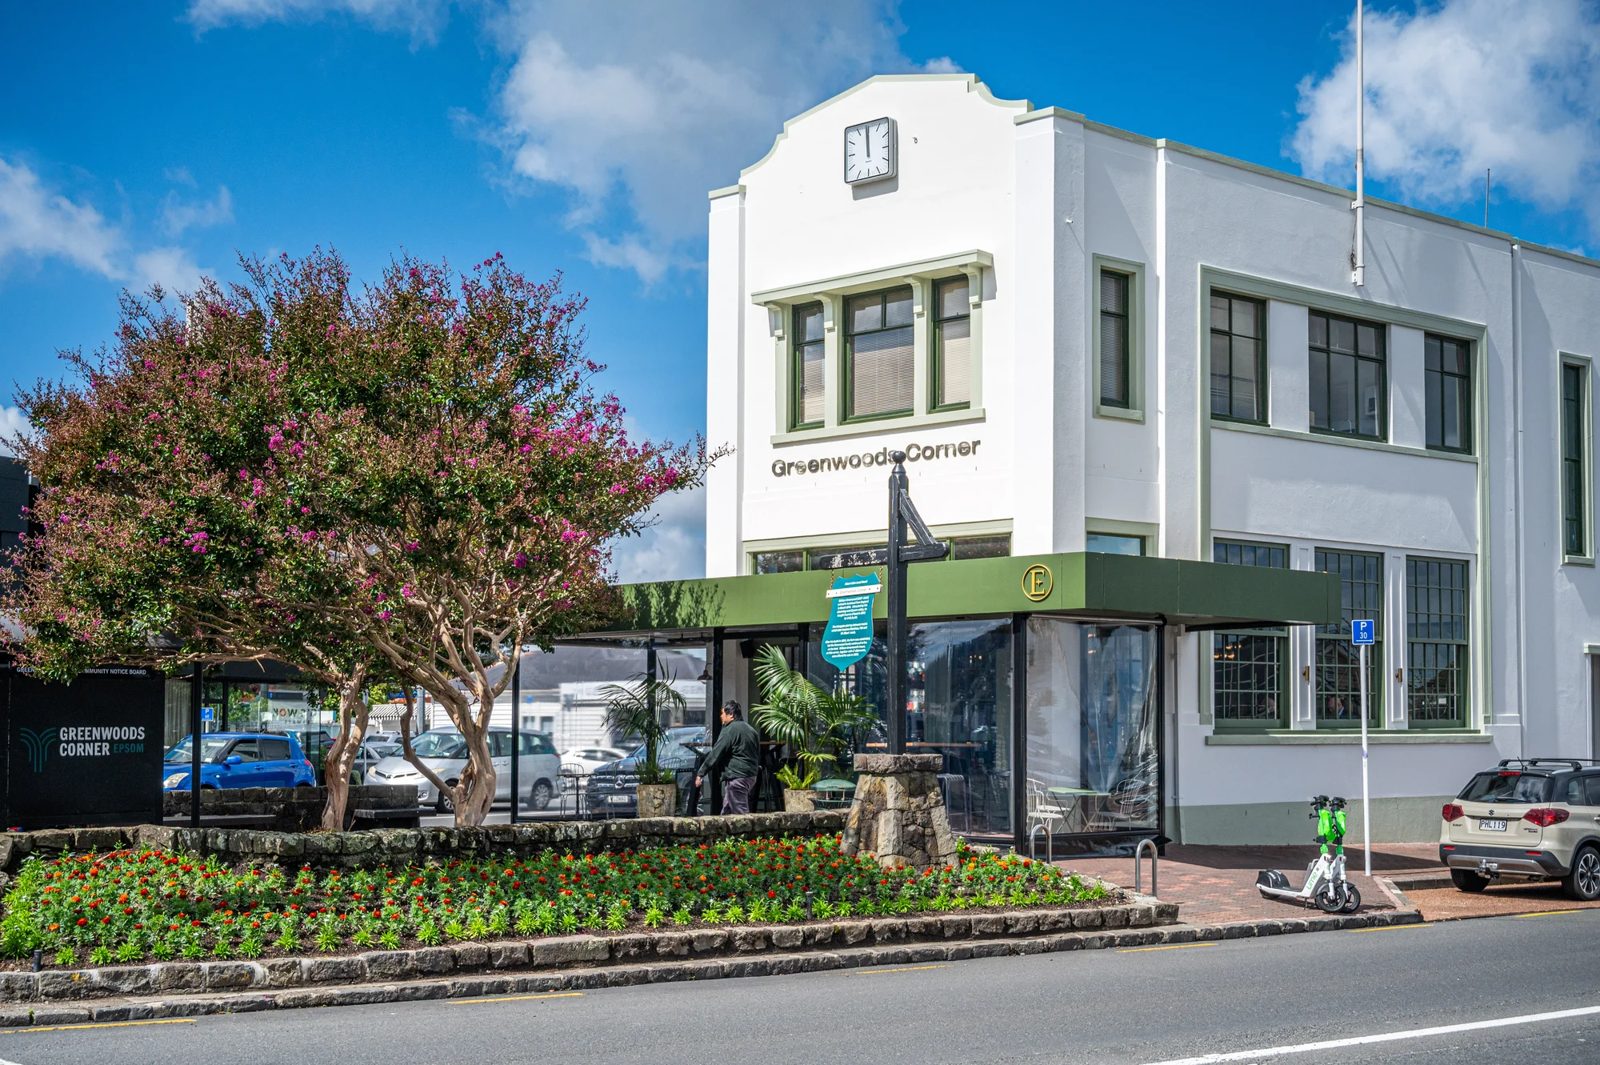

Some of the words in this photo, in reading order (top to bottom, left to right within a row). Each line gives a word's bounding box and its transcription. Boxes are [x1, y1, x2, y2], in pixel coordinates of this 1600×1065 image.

[905, 439, 981, 463] Corner
[1029, 569, 1046, 596] E
[1360, 621, 1368, 631] P
[1359, 631, 1368, 640] 30
[129, 668, 147, 676] BOARD
[59, 726, 146, 741] GREENWOODS
[59, 742, 111, 757] CORNER
[113, 743, 144, 753] EPSOM
